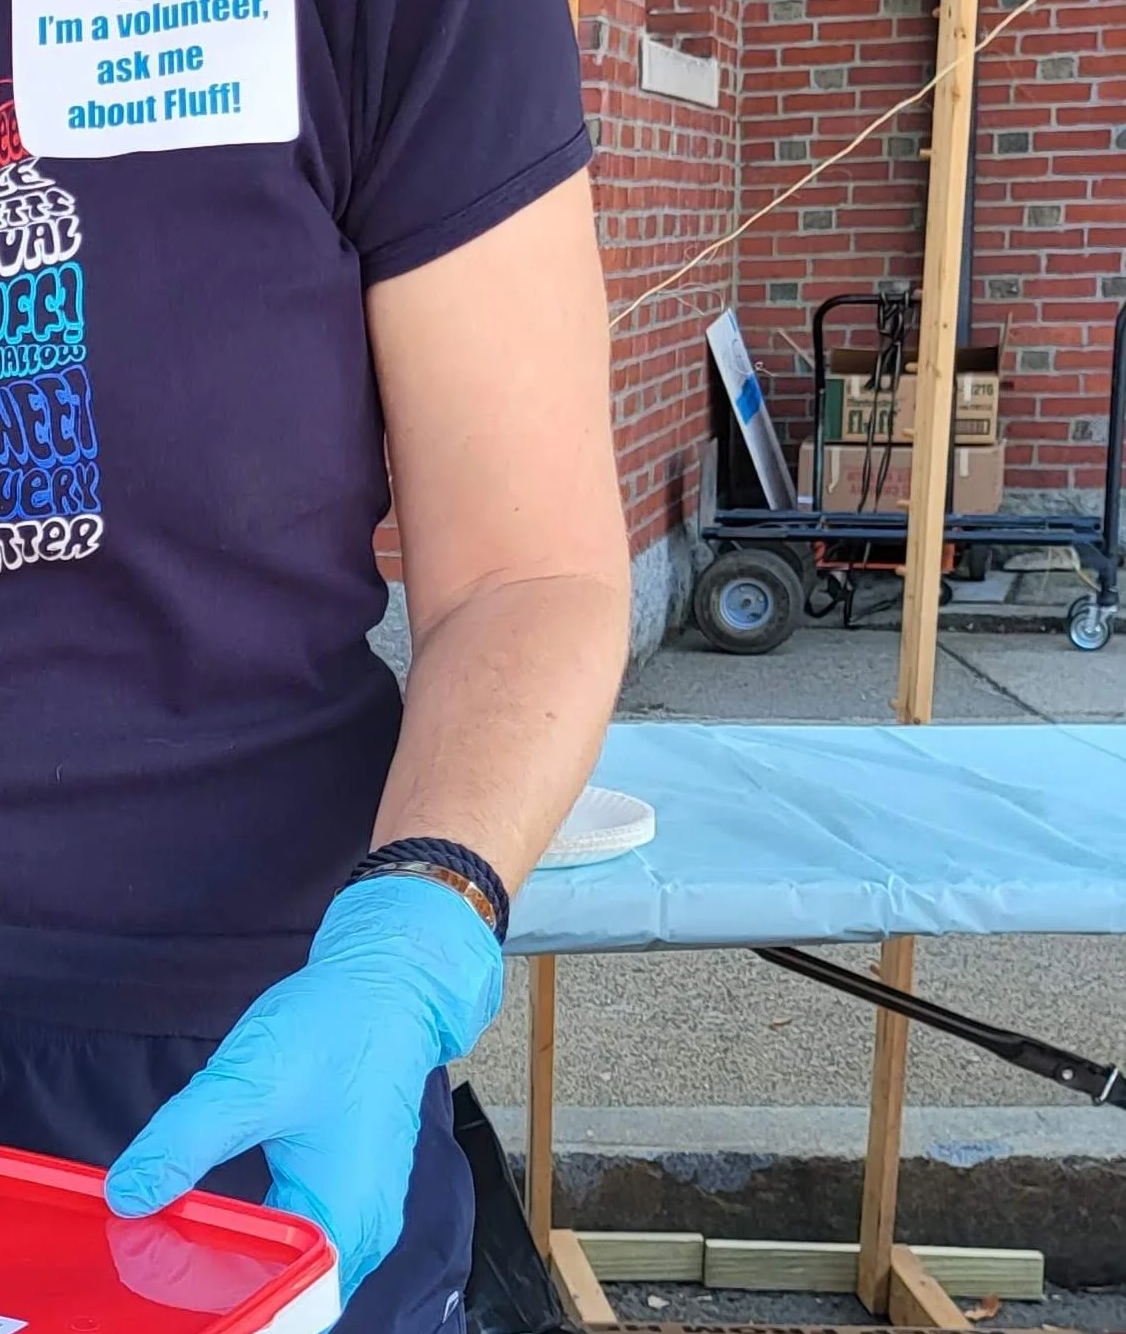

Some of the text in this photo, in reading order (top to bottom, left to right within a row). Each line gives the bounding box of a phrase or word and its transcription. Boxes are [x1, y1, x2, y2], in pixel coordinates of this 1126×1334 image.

[38, 15, 83, 45] I'm
[91, 15, 109, 41] a
[97, 45, 203, 85] ask me
[68, 82, 242, 129] about Fluff!
